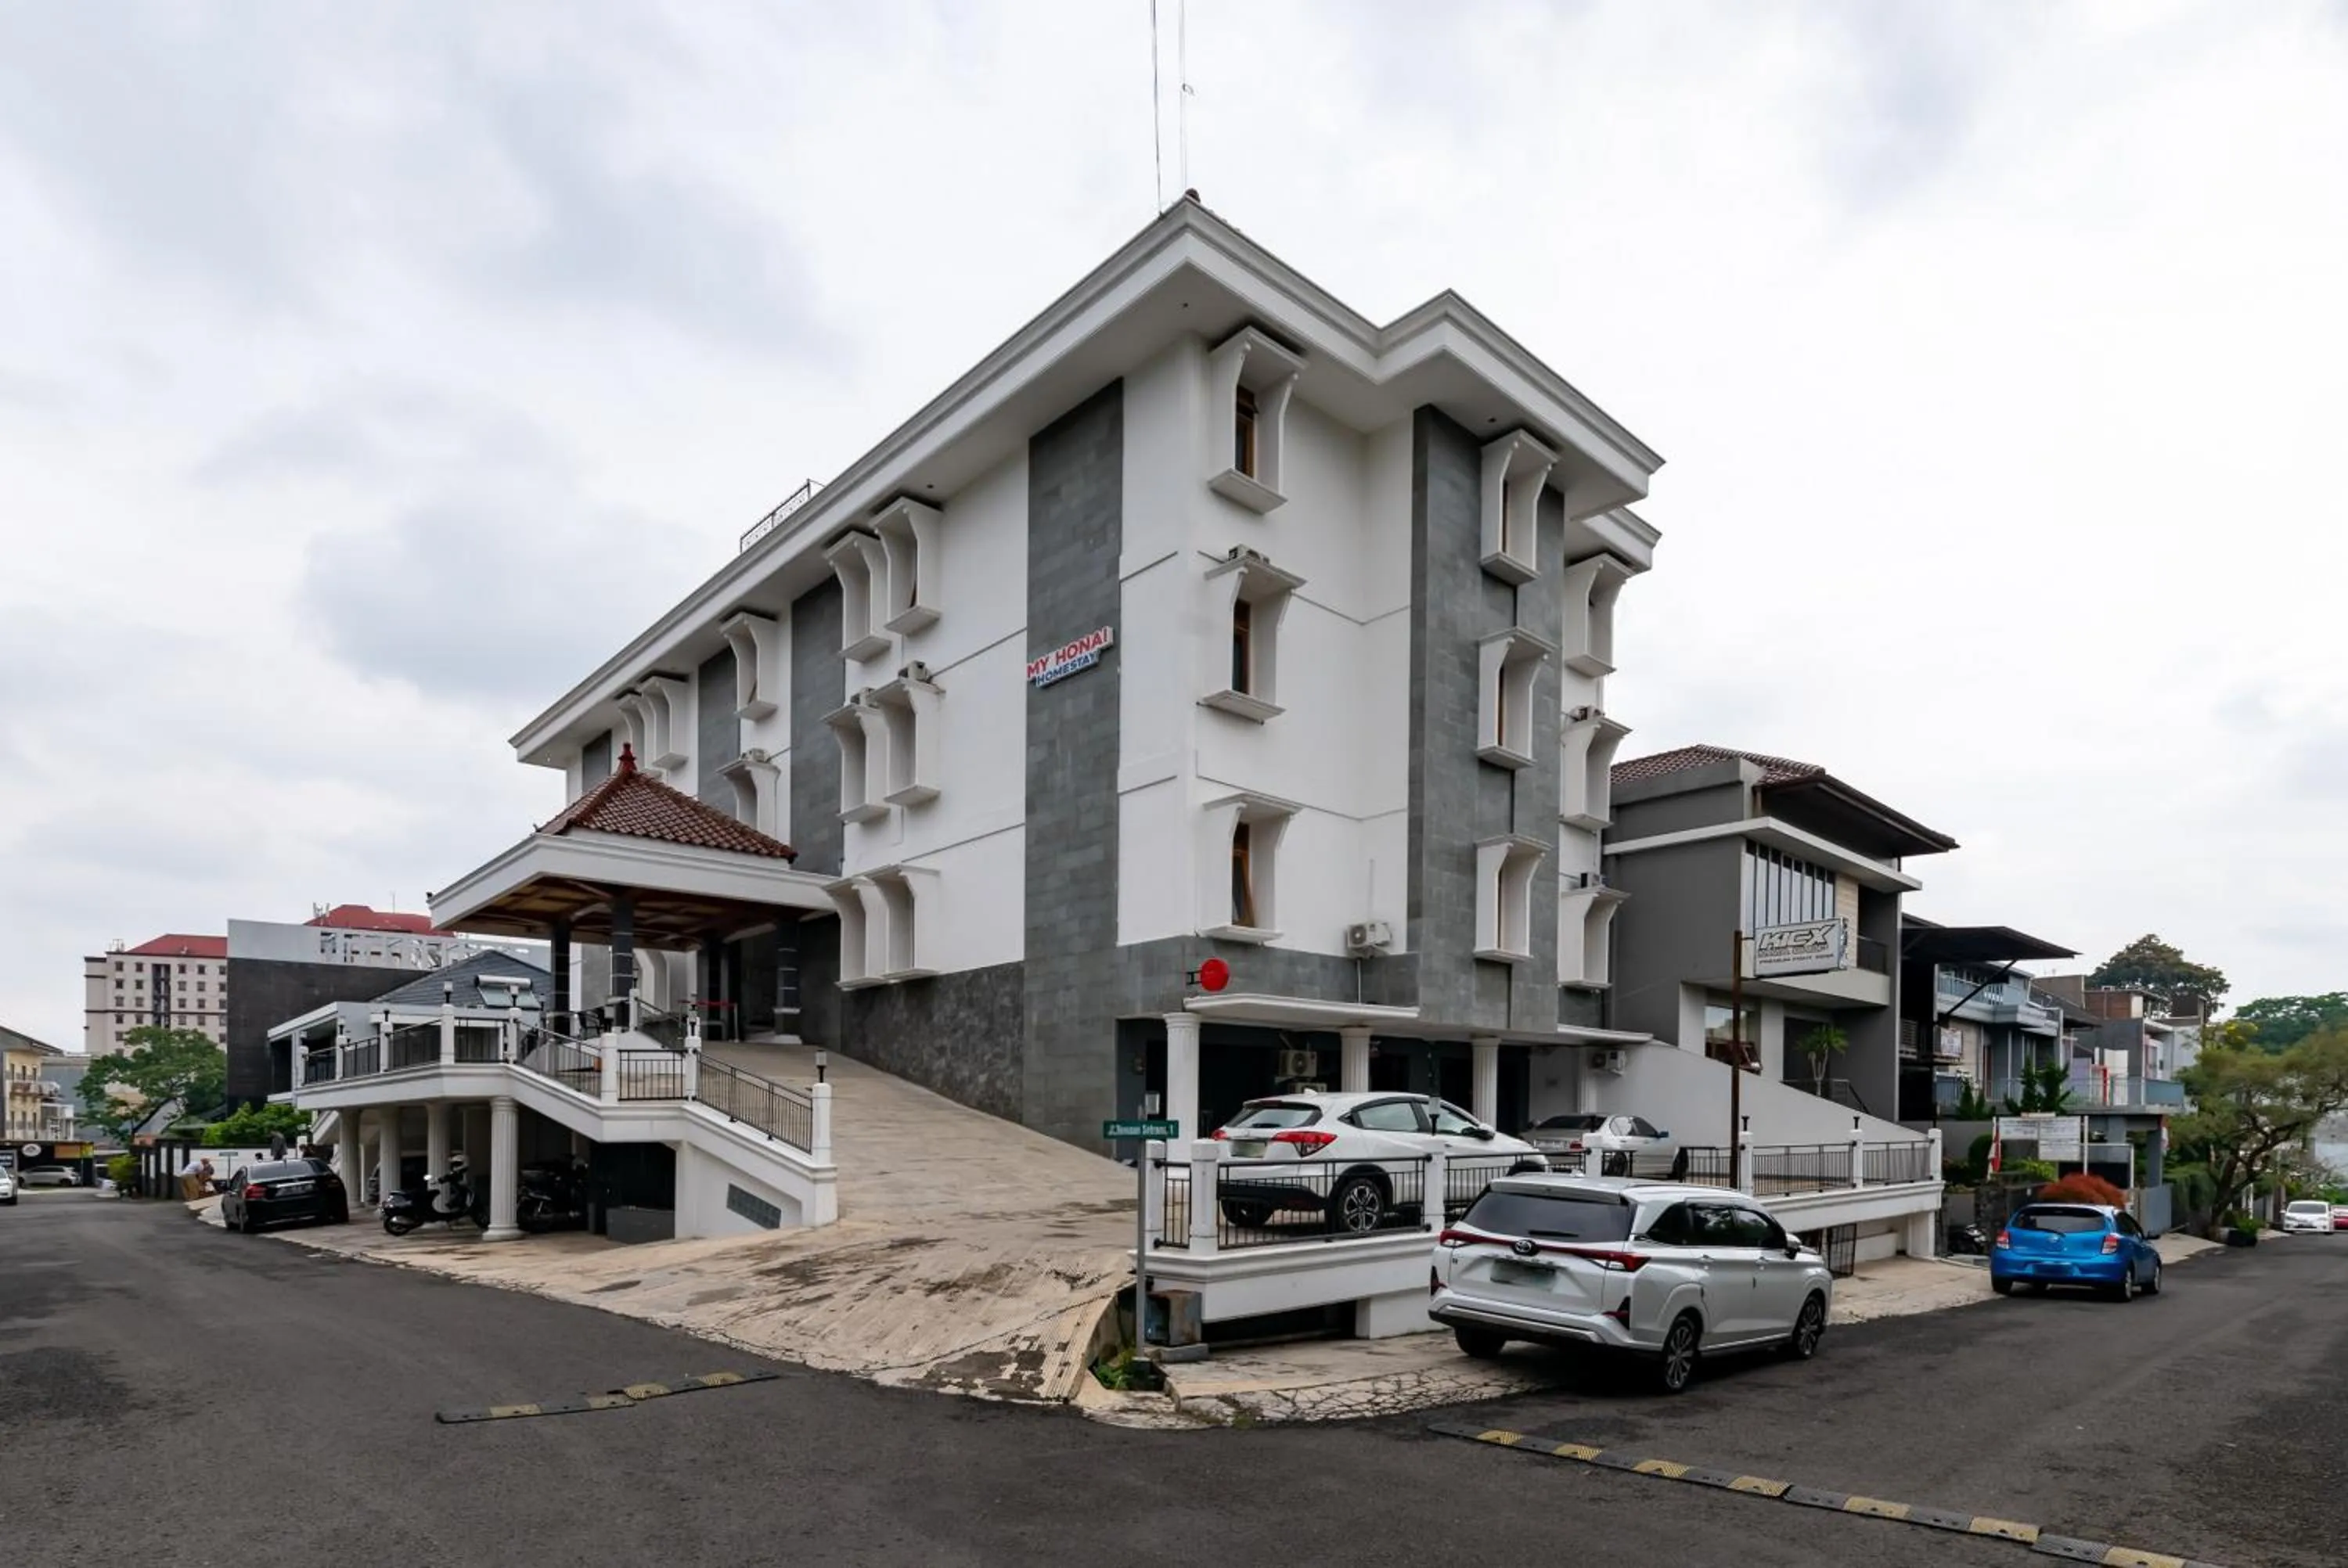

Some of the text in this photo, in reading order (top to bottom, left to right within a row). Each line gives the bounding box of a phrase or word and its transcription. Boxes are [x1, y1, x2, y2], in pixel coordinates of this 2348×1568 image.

[1027, 628, 1108, 678] MY HONAI
[1036, 652, 1097, 685] HOMESTAY
